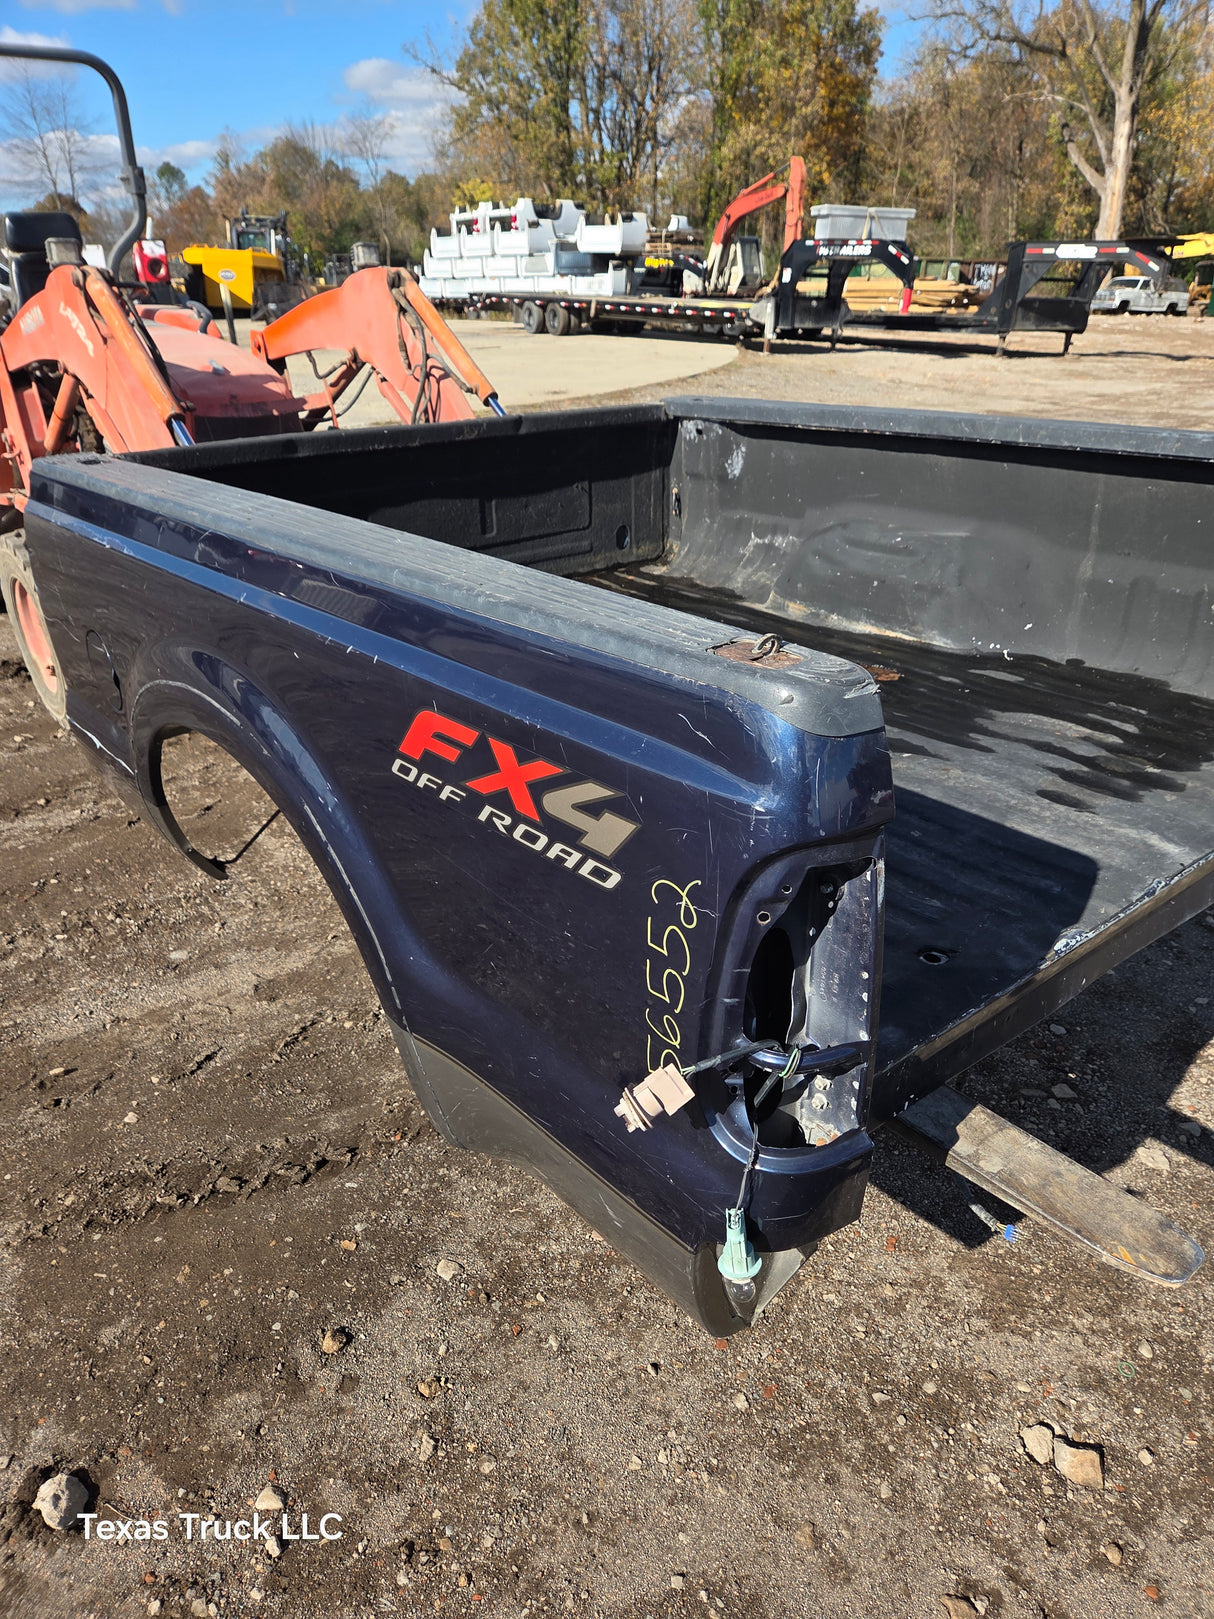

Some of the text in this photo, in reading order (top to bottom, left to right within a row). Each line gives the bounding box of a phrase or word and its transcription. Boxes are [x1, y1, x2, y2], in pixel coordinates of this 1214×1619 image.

[391, 758, 623, 890] OFF ROAD
[398, 710, 641, 859] FX4
